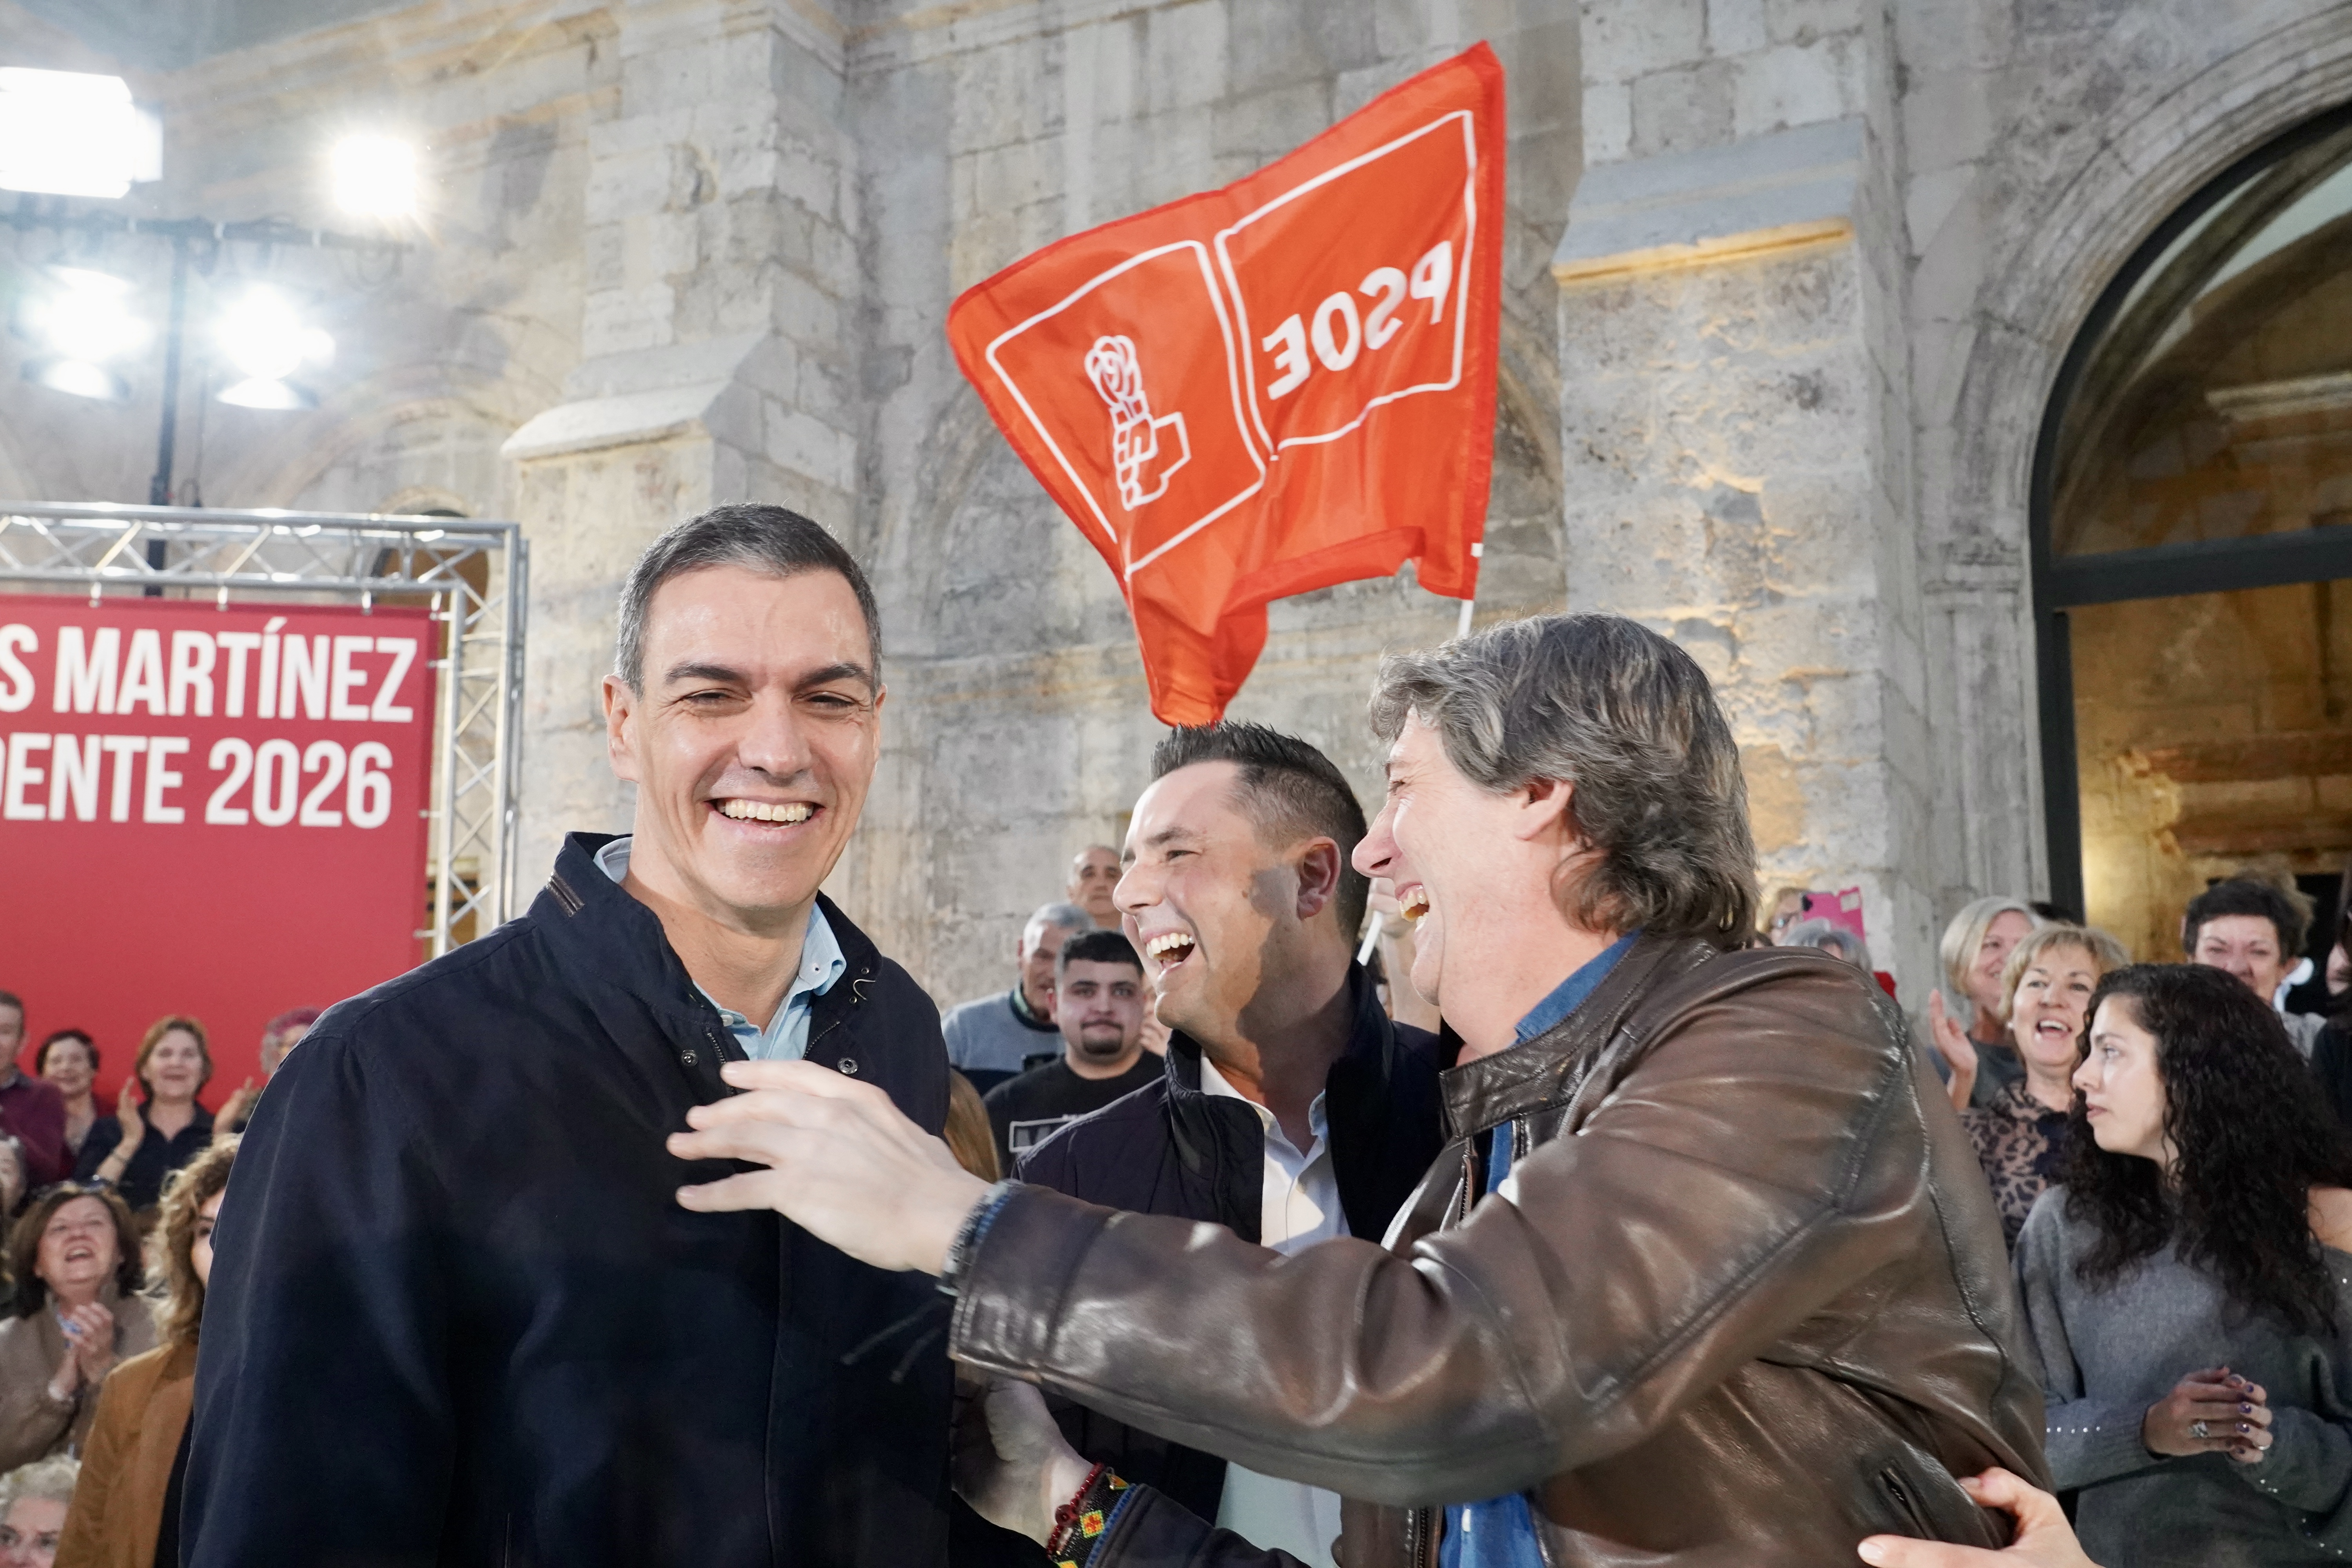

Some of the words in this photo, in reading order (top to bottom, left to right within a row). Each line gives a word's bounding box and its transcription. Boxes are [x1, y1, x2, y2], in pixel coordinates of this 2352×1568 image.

[53, 616, 417, 722] MARTÍNEZ
[0, 732, 190, 824] ENTE
[205, 737, 393, 829] 2026
